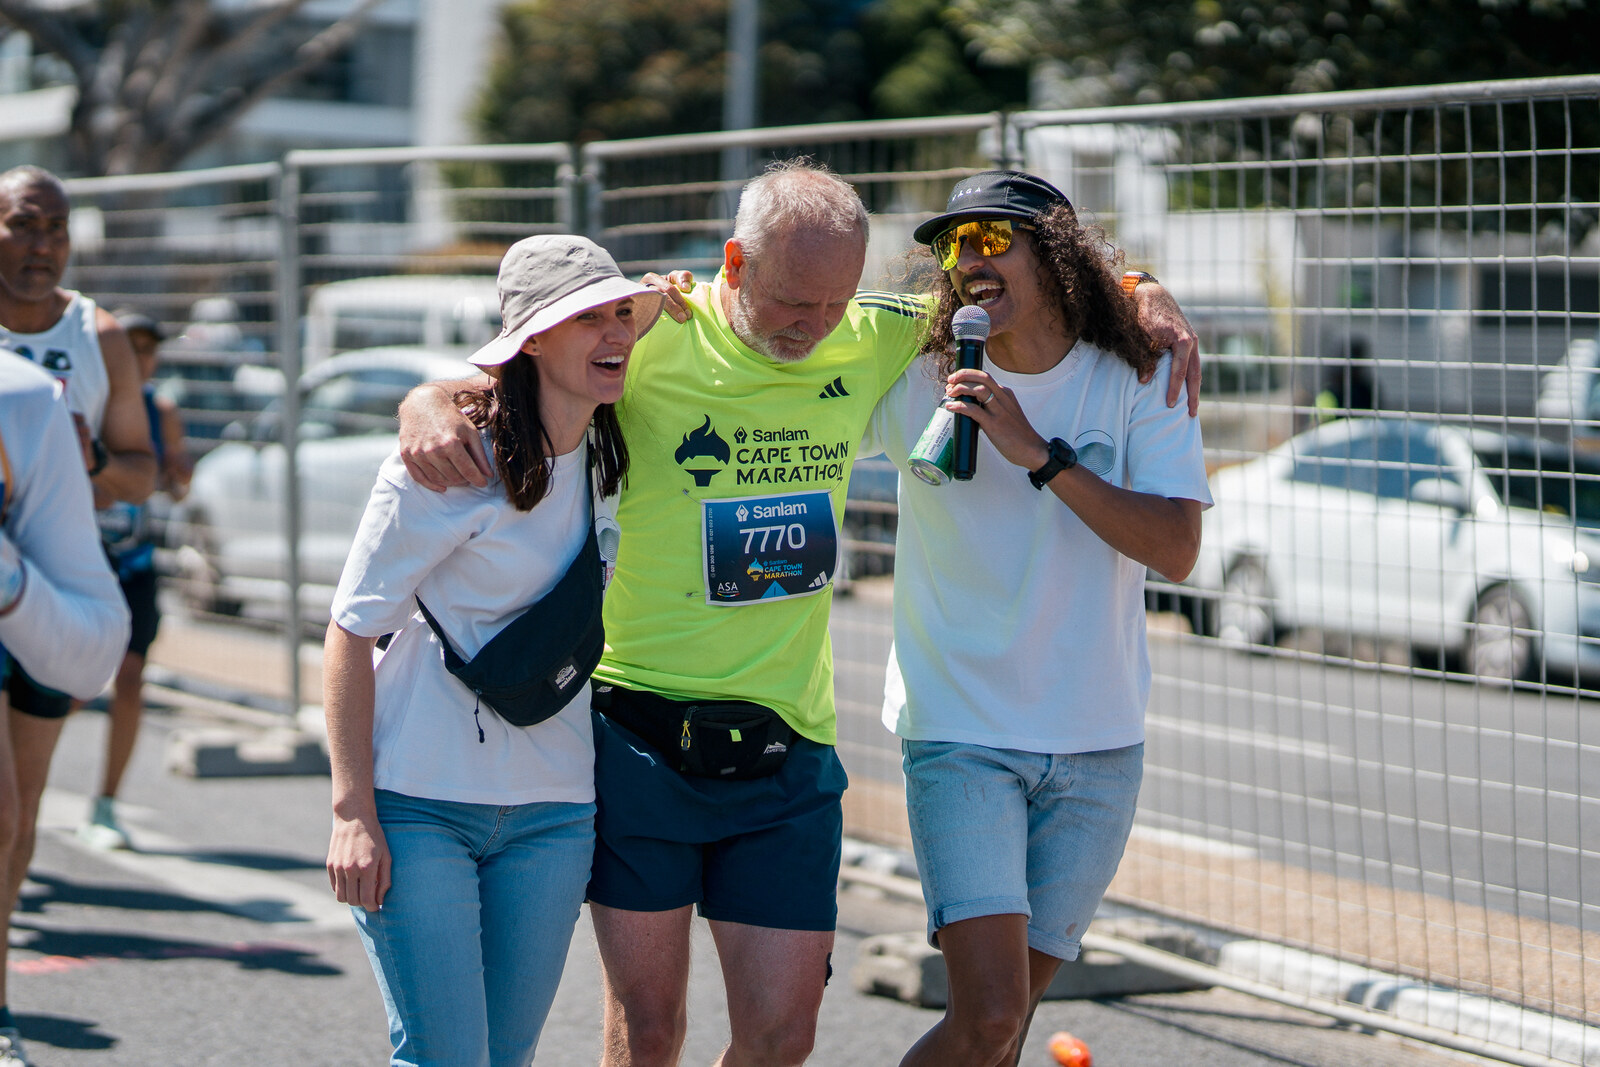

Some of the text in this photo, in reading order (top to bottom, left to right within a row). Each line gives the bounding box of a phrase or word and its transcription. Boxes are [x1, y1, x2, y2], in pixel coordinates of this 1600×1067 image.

[753, 427, 809, 442] Sanlam
[736, 441, 849, 464] CAPE TOWN
[736, 461, 846, 485] MARATHON
[753, 502, 807, 519] Sanlam
[739, 523, 806, 554] 7770
[764, 562, 803, 573] CAPE TOWN
[764, 569, 803, 580] MARATHON
[717, 582, 738, 591] ASA
